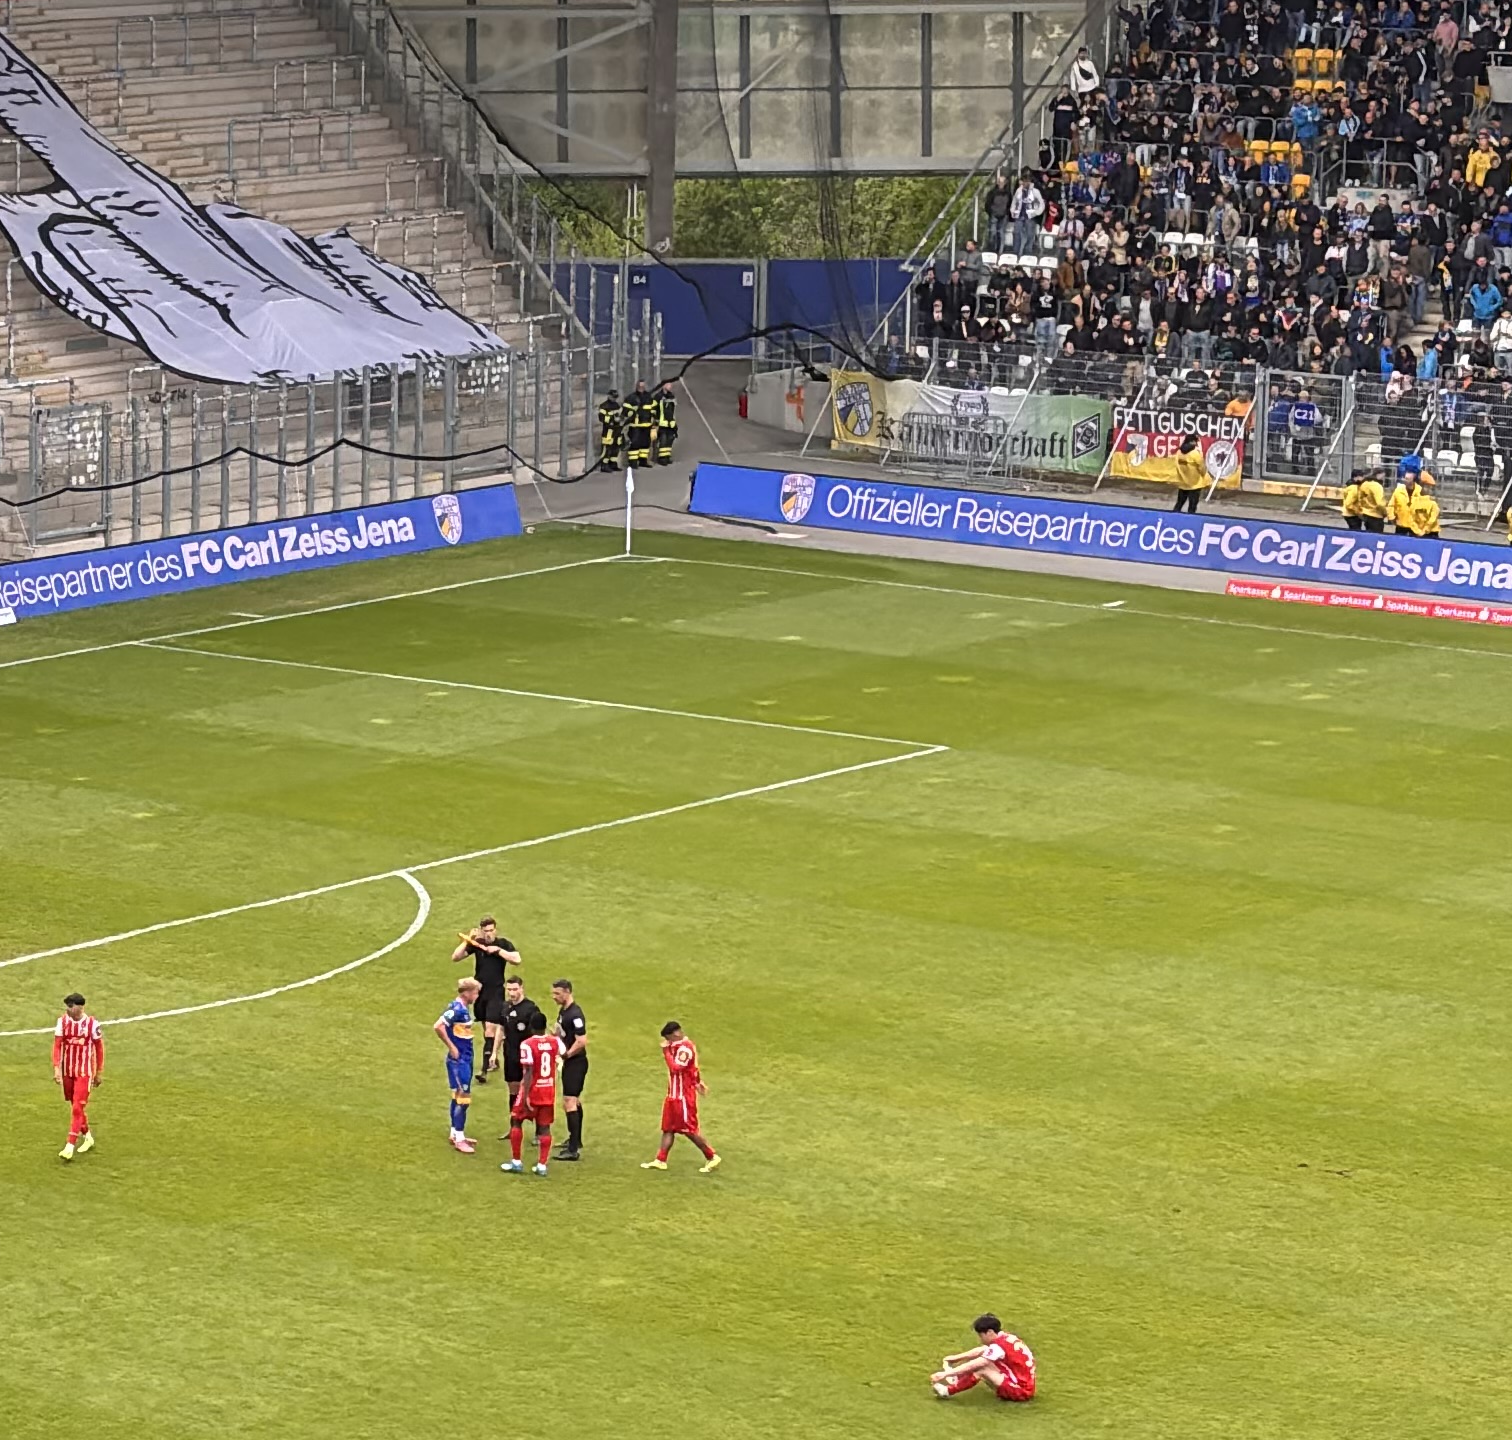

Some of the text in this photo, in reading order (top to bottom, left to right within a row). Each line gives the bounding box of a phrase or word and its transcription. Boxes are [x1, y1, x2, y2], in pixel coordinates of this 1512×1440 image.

[1113, 405, 1245, 441] FETTGUSCHEN
[826, 480, 950, 530] Offizieller
[953, 491, 1134, 556] Reisepartner
[1138, 509, 1195, 556] des
[1196, 519, 1251, 560] FC
[1251, 524, 1319, 569] Carl
[1317, 535, 1423, 581] Zeiss
[138, 553, 182, 583] des
[183, 539, 223, 578] FC
[223, 529, 281, 572] Carl
[282, 517, 351, 564] Zeiss
[352, 511, 415, 552] Jena
[1283, 590, 1324, 603] Sparkasse
[1434, 605, 1476, 619] Sparkasse
[540, 1050, 552, 1078] 8
